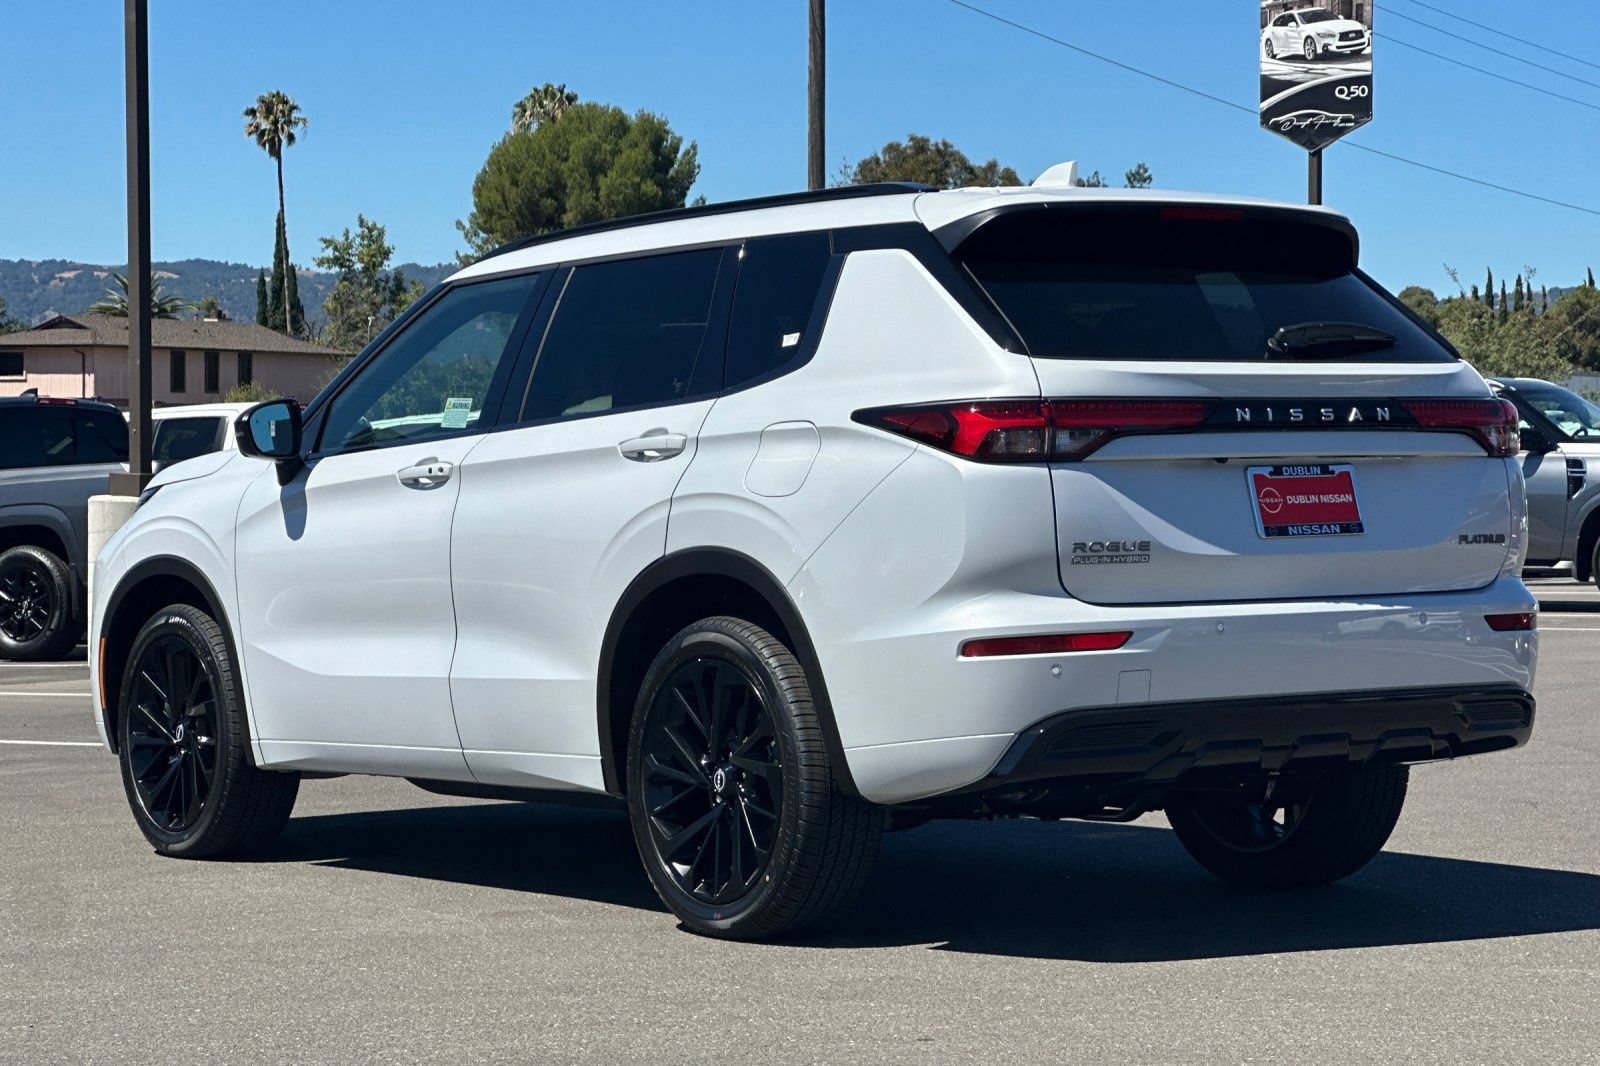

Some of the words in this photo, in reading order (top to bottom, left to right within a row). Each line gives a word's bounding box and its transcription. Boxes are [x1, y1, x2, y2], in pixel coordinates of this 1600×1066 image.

[1334, 85, 1369, 101] Q50
[1235, 407, 1390, 422] NISSAN
[1282, 466, 1322, 476] DUBLIN
[1286, 494, 1319, 505] DUBLIN
[1320, 493, 1353, 504] NISSAN
[1287, 524, 1341, 536] NISSAN
[1071, 540, 1151, 554] ROGUE
[1073, 555, 1111, 564] PLUG-IN
[1113, 554, 1149, 563] HYBRID
